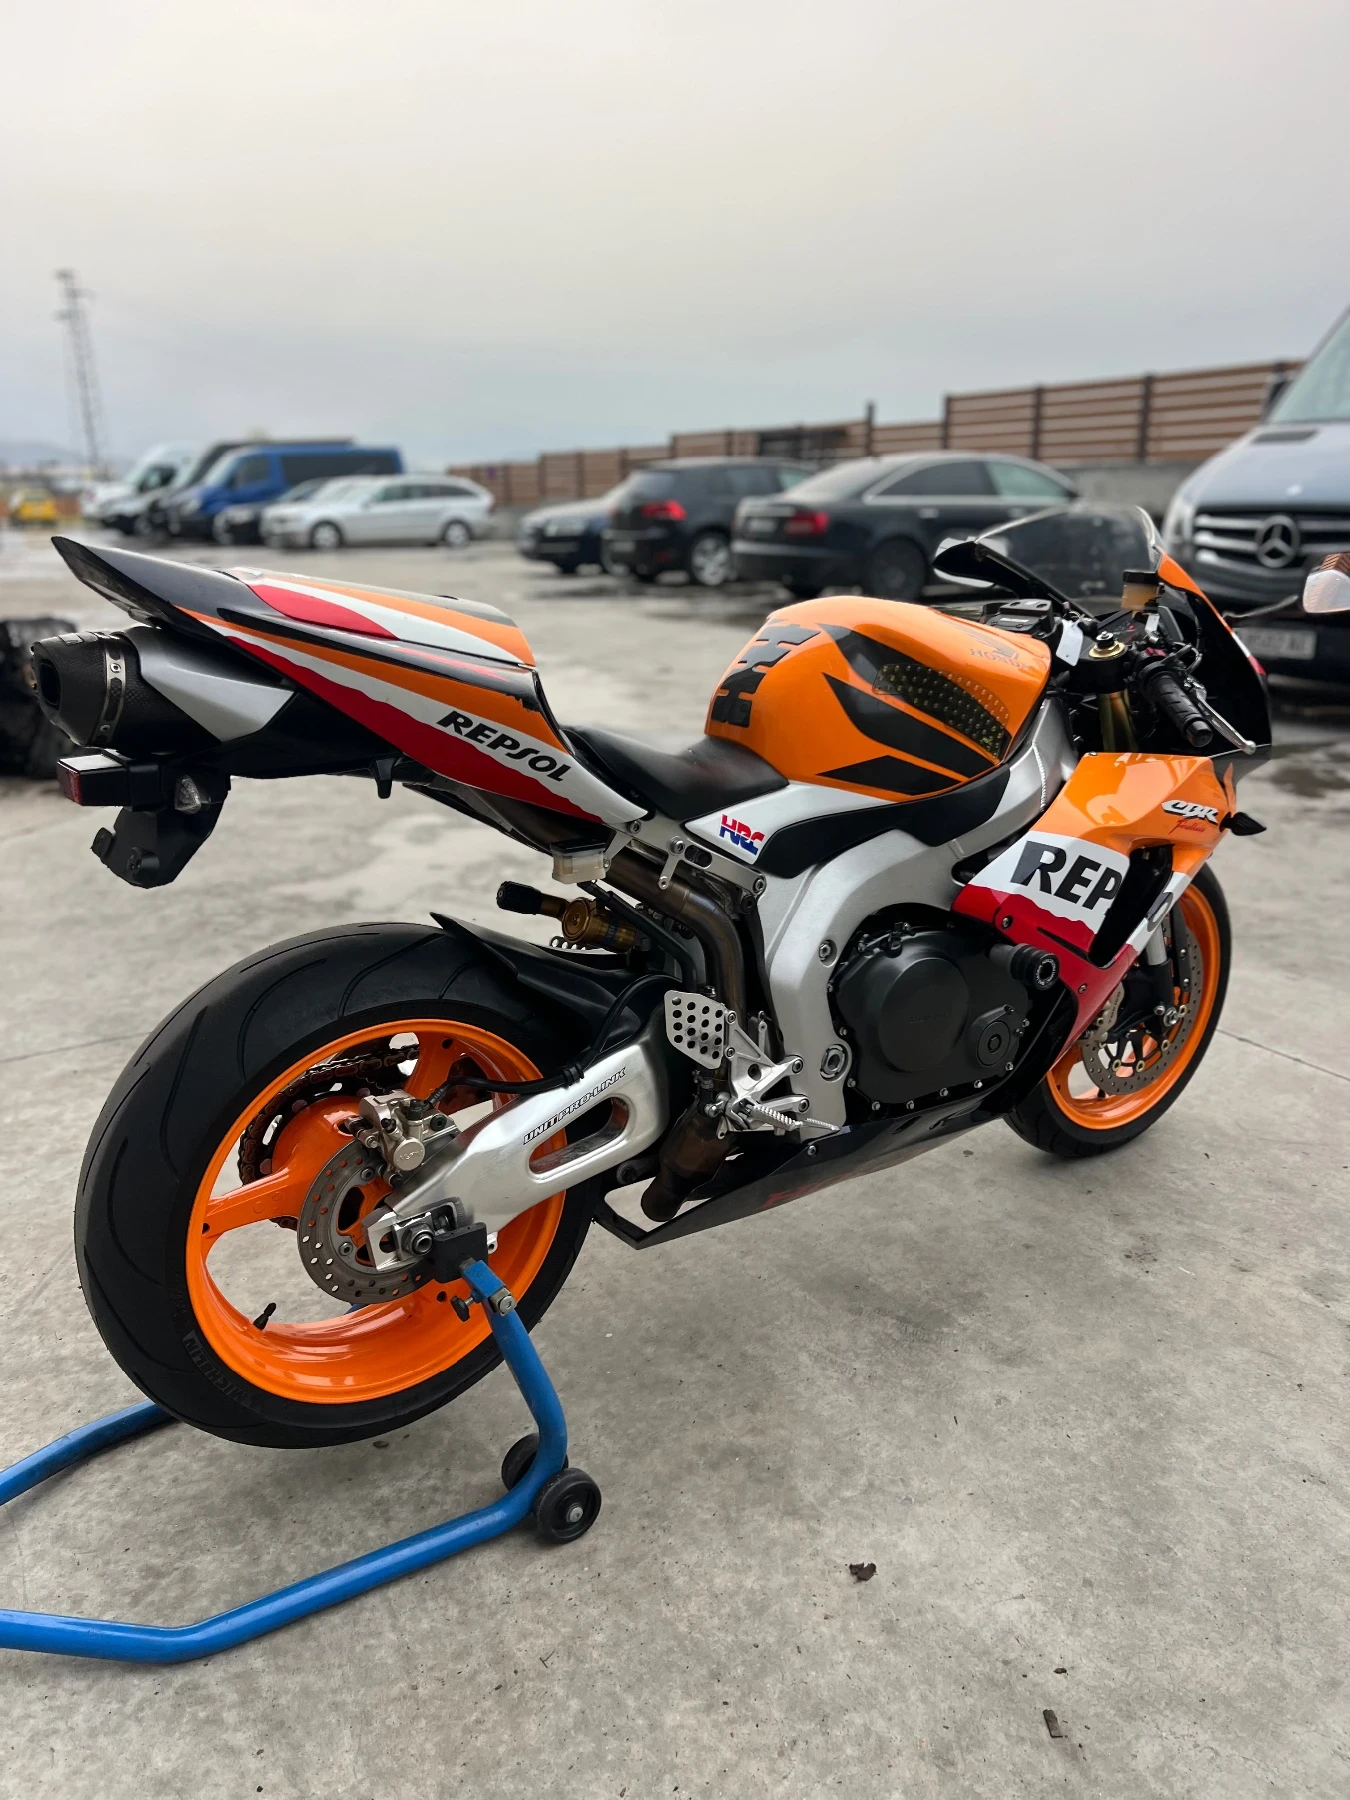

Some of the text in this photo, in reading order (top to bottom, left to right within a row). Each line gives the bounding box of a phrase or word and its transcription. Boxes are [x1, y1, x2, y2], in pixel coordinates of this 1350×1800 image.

[436, 710, 571, 782] REPSOL
[1161, 799, 1219, 826] CBR
[719, 813, 766, 856] HRC
[523, 1113, 559, 1146] UNIT
